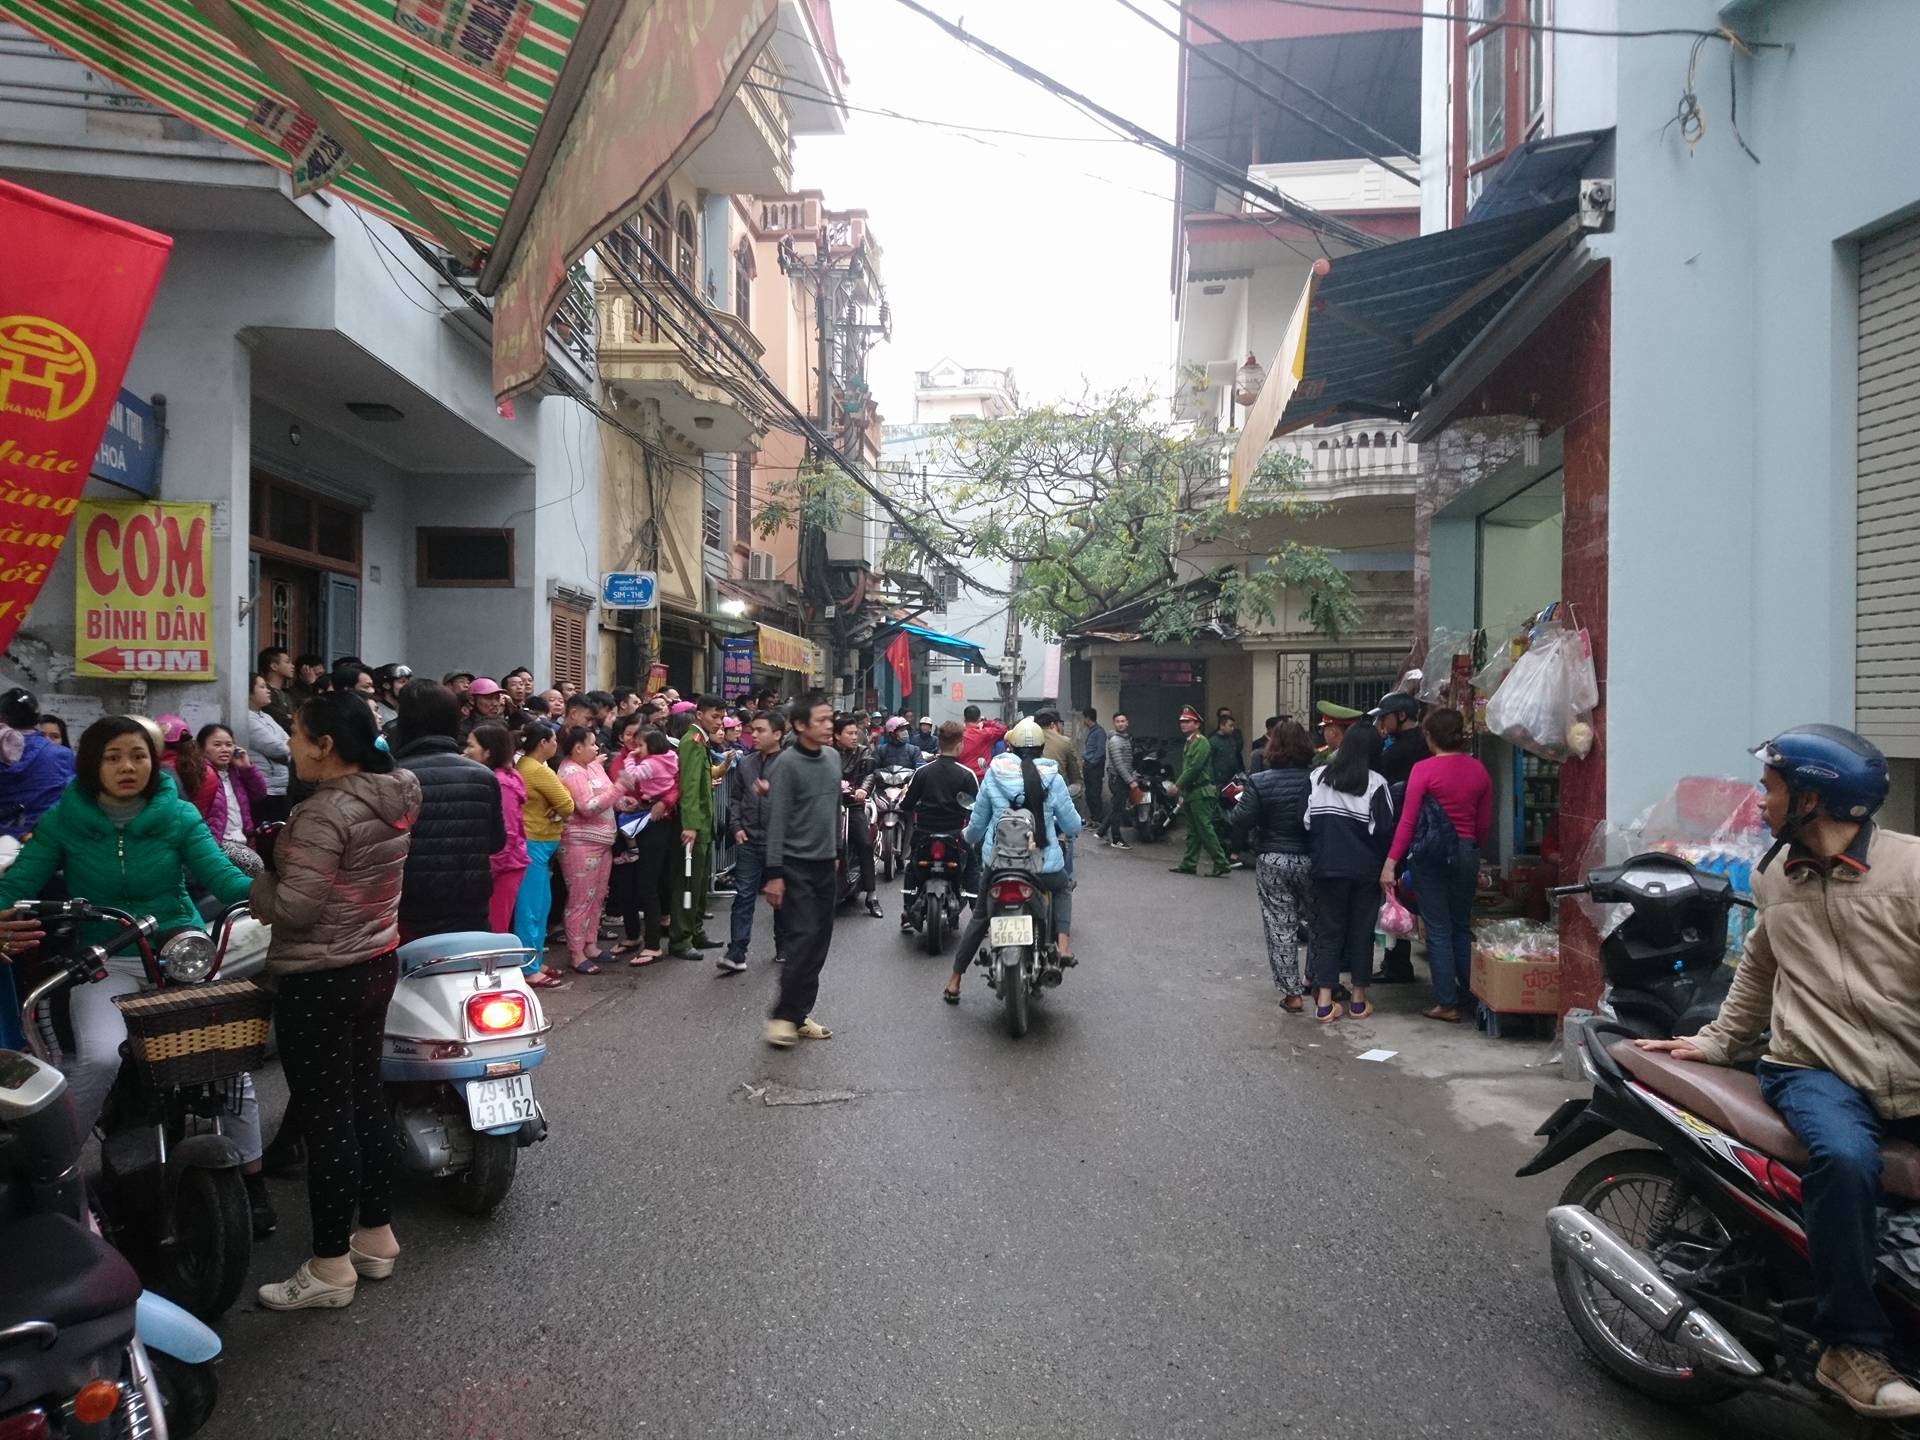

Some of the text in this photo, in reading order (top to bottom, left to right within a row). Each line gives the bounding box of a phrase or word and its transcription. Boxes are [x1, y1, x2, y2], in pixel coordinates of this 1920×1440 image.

[0, 440, 79, 474] húc
[0, 480, 79, 516] ừng
[0, 521, 65, 549] ăm
[84, 505, 206, 598] CƠM
[612, 591, 626, 599] SIM
[86, 603, 206, 641] BÌNH DÂN
[117, 651, 200, 671] 10M
[475, 1098, 534, 1126] 431.62
